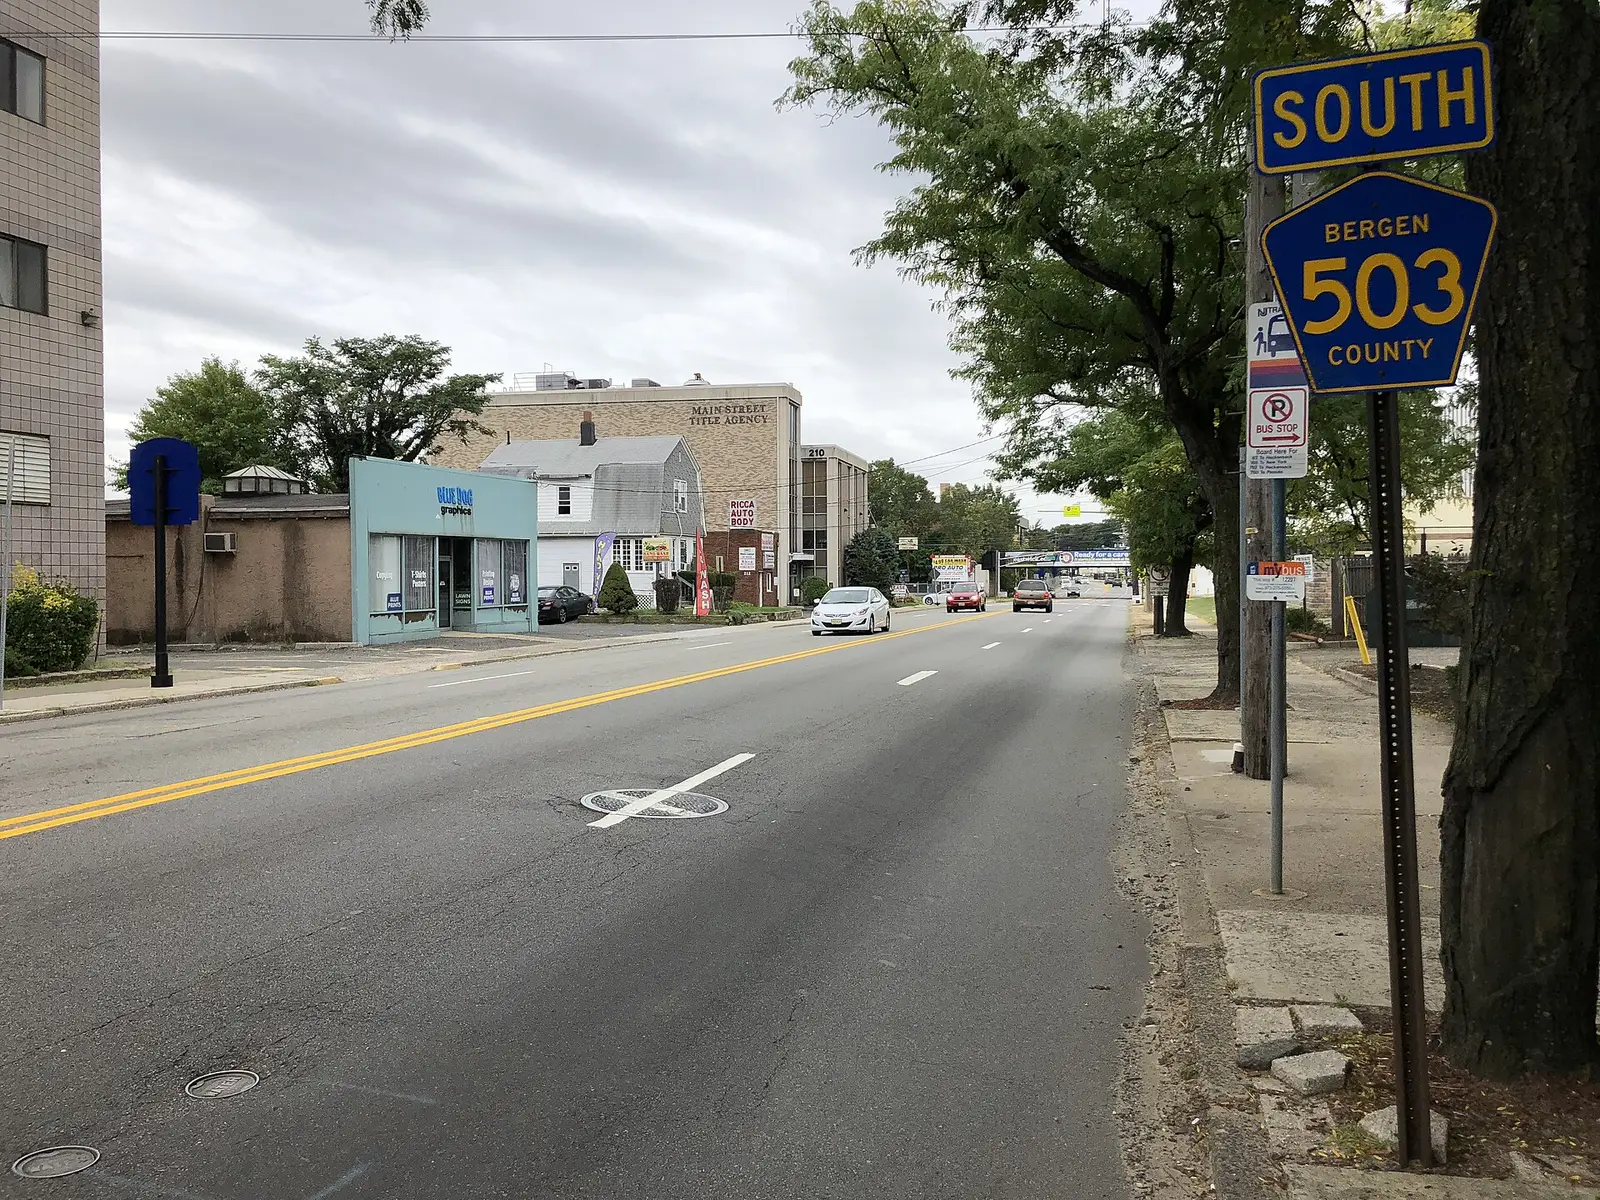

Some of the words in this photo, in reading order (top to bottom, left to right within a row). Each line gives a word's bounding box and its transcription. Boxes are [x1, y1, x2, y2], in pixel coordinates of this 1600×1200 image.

[1273, 66, 1476, 149] SOUTH
[1325, 213, 1430, 243] BERGEN
[1303, 247, 1465, 334] 503
[1328, 337, 1434, 366] COUNTY
[692, 406, 721, 414] MAIN
[725, 405, 767, 413] STREET
[690, 417, 720, 425] TITLE
[725, 415, 768, 424] AGENCY
[1256, 424, 1273, 433] BUS
[1276, 423, 1298, 433] STOP
[808, 449, 825, 457] 210
[437, 486, 456, 504] BLUE
[456, 487, 473, 506] DOG
[731, 501, 754, 509] RICCA
[441, 505, 471, 516] graphics
[731, 510, 753, 518] AUTO
[1074, 551, 1095, 559] Ready
[1264, 564, 1303, 578] mybus
